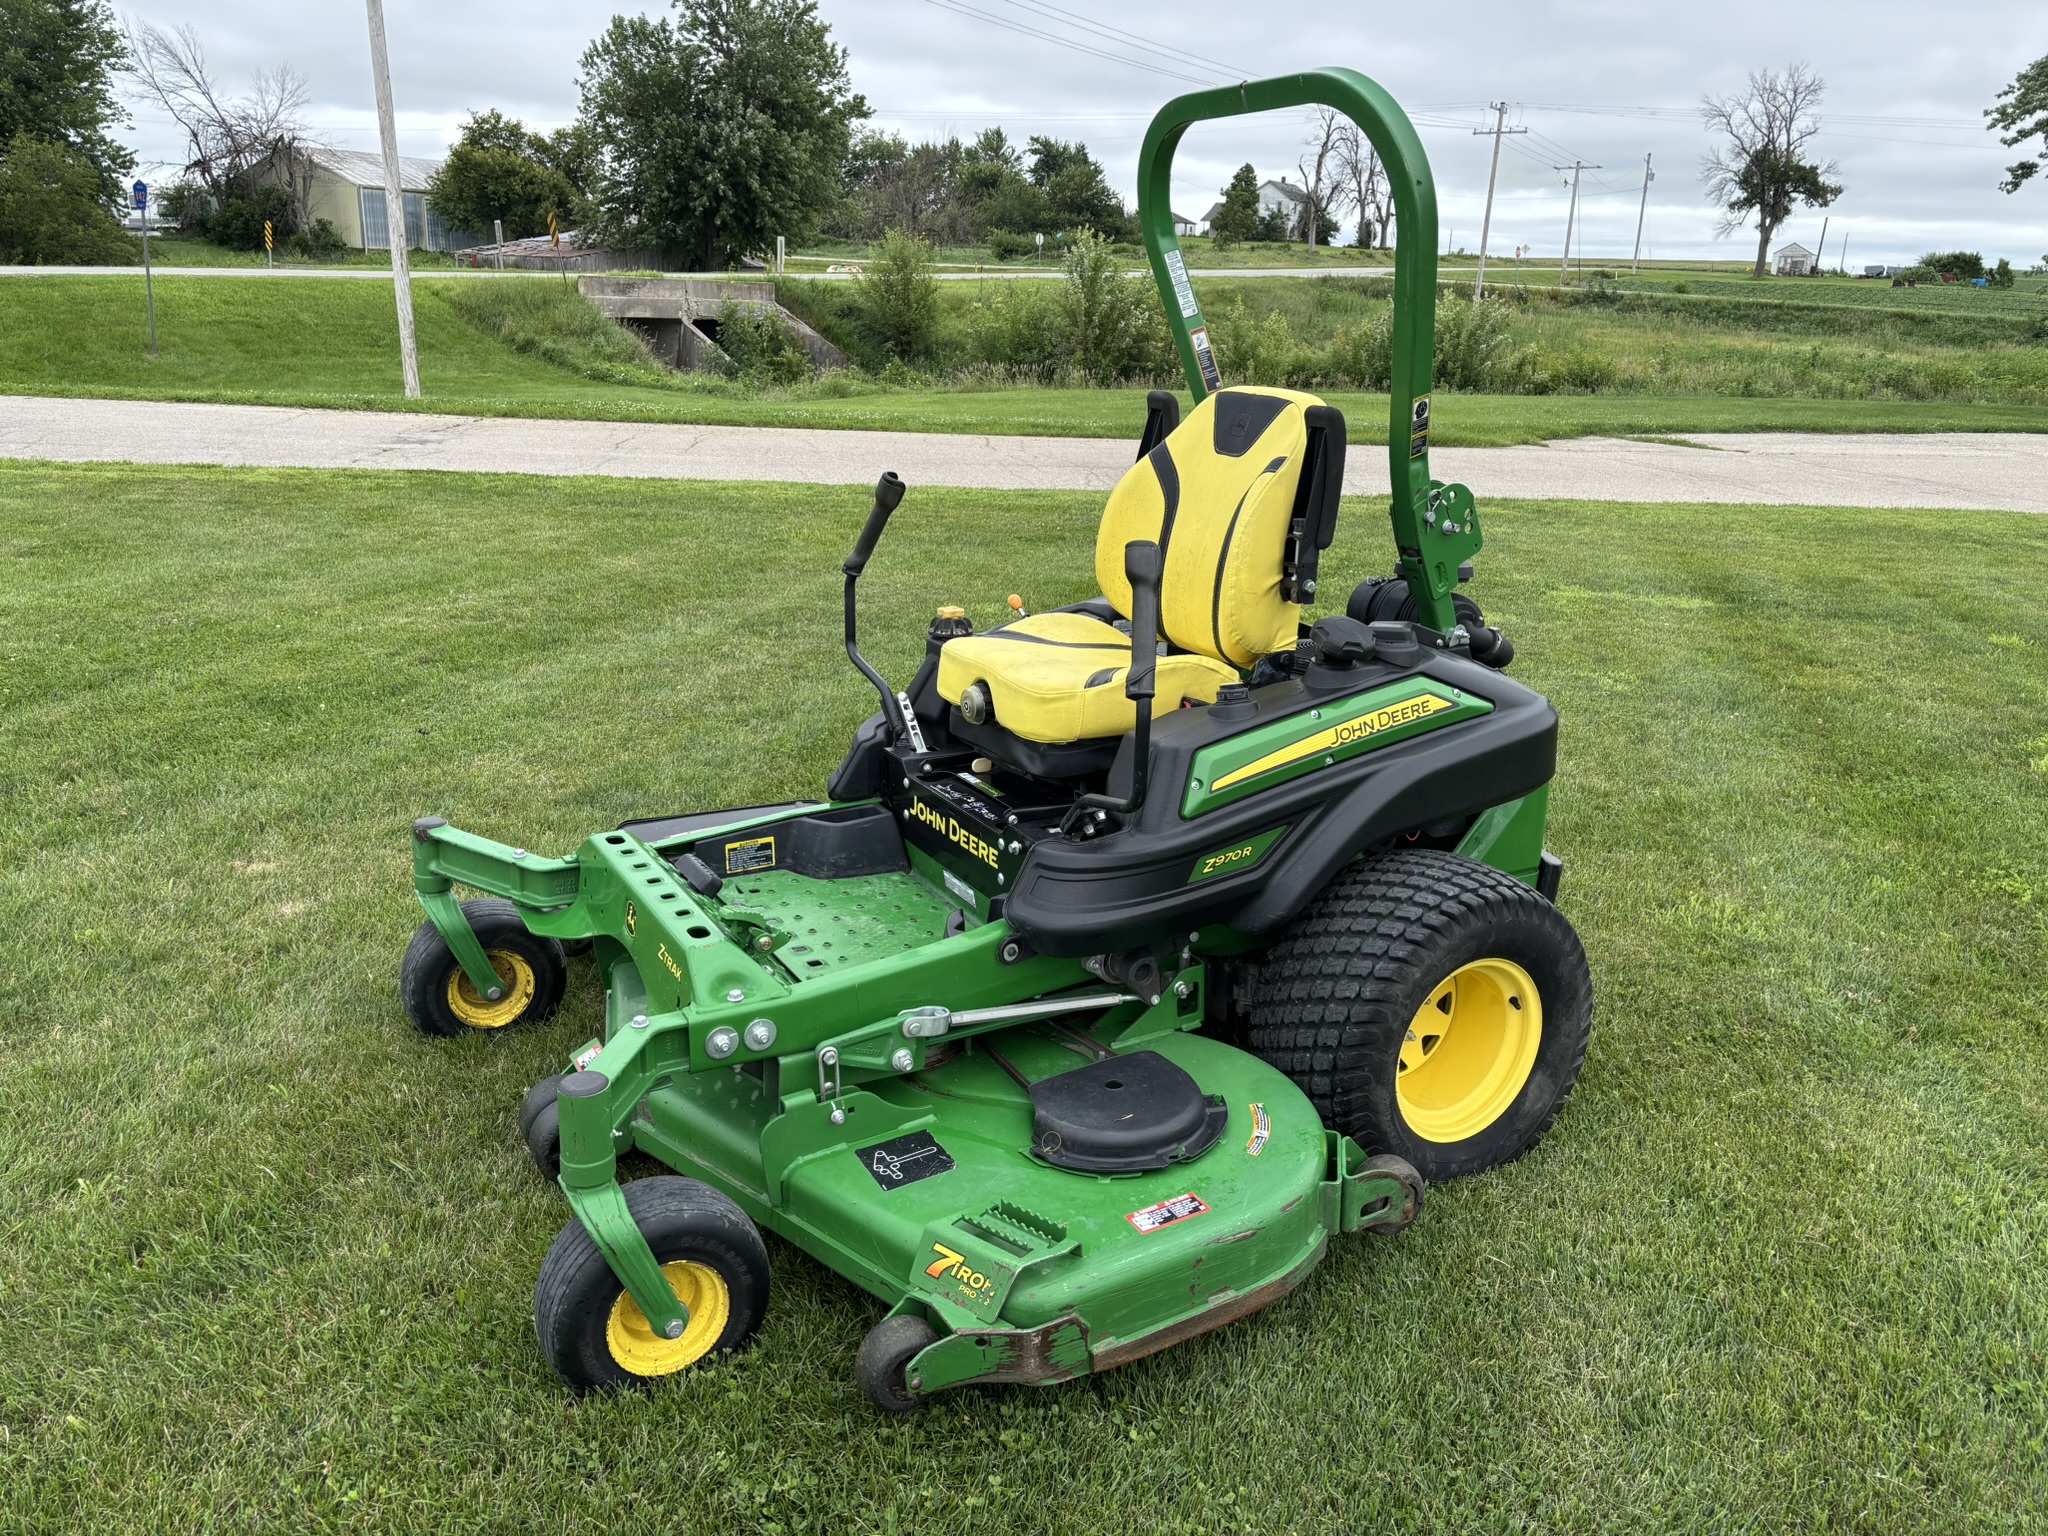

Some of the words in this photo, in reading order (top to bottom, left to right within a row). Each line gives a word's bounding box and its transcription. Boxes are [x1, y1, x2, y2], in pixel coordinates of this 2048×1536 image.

[1331, 718, 1375, 746] JOHN
[1378, 699, 1432, 728] DEERE
[909, 795, 946, 835] JOHN
[948, 817, 999, 870] DEERE
[1202, 846, 1253, 874] Z970R
[657, 942, 683, 983] ZTRAK
[958, 1284, 977, 1299] PRO
